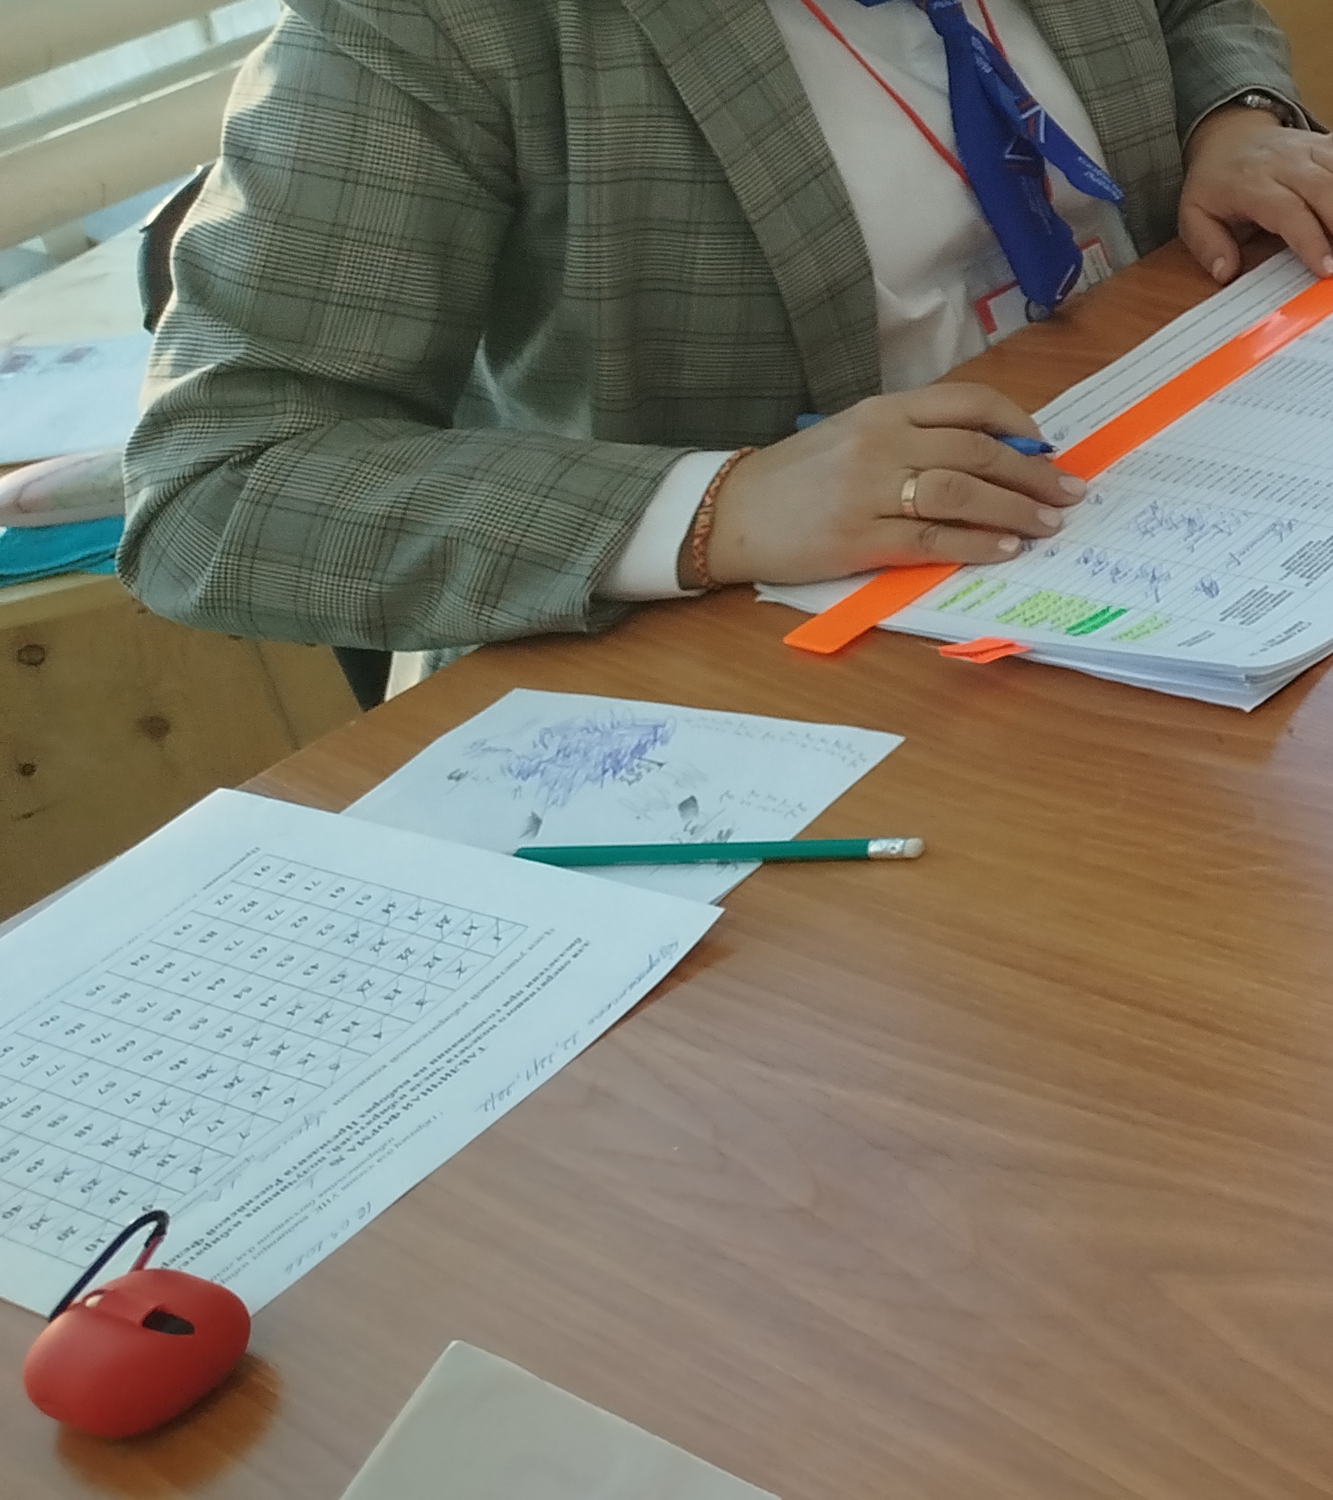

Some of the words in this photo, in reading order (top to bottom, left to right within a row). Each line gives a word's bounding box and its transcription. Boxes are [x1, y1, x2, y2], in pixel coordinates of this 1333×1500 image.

[254, 866, 270, 876] 91
[279, 872, 295, 883] 81
[304, 881, 321, 891] 71
[329, 887, 345, 898] 61
[215, 894, 233, 905] 92
[355, 895, 371, 905] 51
[240, 901, 258, 913] 82
[265, 910, 284, 921] 72
[290, 916, 308, 928] 62
[173, 924, 192, 935] 93
[316, 924, 335, 936] 52
[199, 931, 218, 943] 83
[224, 940, 243, 951] 73
[250, 947, 267, 959] 63
[130, 955, 150, 966] 94
[276, 955, 294, 967] 53
[156, 962, 175, 974] 84
[303, 963, 319, 975] 43
[181, 971, 201, 982] 74
[207, 978, 225, 990] 64
[86, 985, 106, 997] 95
[233, 987, 252, 999] 54
[111, 992, 131, 1005] 85
[260, 995, 277, 1007] 44
[136, 1002, 157, 1013] 75
[163, 1009, 181, 1021] 65
[40, 1016, 60, 1027] 96
[189, 1017, 208, 1030] 55
[65, 1023, 85, 1035] 86
[216, 1026, 233, 1039] 45
[90, 1033, 111, 1044] 76
[116, 1040, 136, 1053] 66
[20, 1054, 39, 1068] 87
[142, 1049, 163, 1061] 56
[169, 1058, 187, 1070] 46
[45, 1065, 65, 1077] 77
[71, 1072, 89, 1086] 67
[402, 1047, 486, 1110] ТАБЛИЧНАЯ
[98, 1081, 117, 1095] 57
[125, 1091, 141, 1104] 47
[21, 1105, 41, 1118] 68
[47, 1115, 68, 1128] 58
[74, 1124, 93, 1138] 48
[347, 1112, 400, 1152] ФОРМА
[284, 1121, 358, 1176] Президента
[26, 1159, 44, 1173] 49
[206, 1178, 283, 1236] Российской
